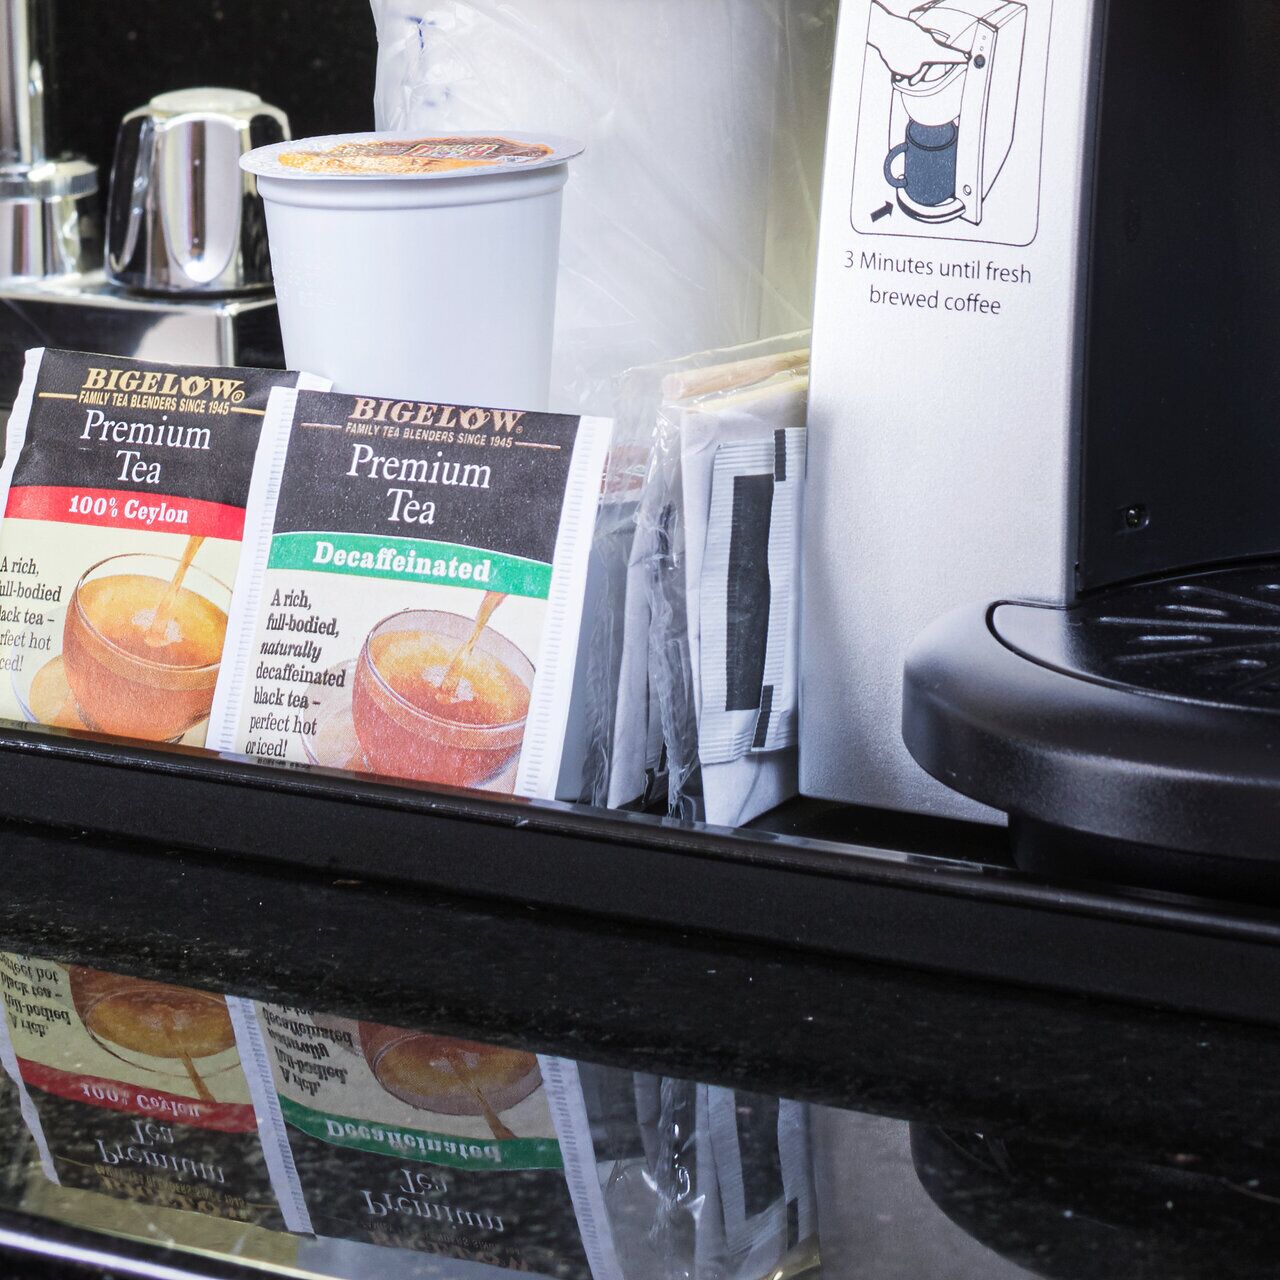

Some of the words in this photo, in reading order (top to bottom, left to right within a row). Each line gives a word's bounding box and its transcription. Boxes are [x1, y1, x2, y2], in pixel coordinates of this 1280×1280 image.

[843, 250, 854, 269] 3
[860, 251, 934, 276] Minutes
[939, 260, 981, 280] until
[986, 261, 1032, 284] fresh
[869, 284, 939, 309] brewed
[944, 293, 1002, 315] coffee
[78, 390, 110, 406] FAMILY
[112, 394, 128, 408] TEA
[130, 395, 177, 412] BLENDERS
[179, 398, 206, 414] SINCE
[208, 401, 230, 416] 1945
[79, 409, 211, 450] Premium
[345, 421, 380, 437] FAMILY
[382, 425, 400, 438] TEA
[402, 427, 455, 443] BLENDERS
[457, 432, 487, 446] SINCE
[489, 435, 514, 449] 1945
[115, 449, 162, 484] Tea
[345, 443, 492, 489] Premium
[68, 495, 118, 518] 100%
[124, 499, 189, 525] Ceylon
[386, 487, 436, 525] Tea
[0, 556, 8, 573] A
[11, 556, 40, 577] rich,
[312, 540, 493, 582] Decaffeinated
[270, 588, 281, 606] A
[283, 588, 312, 610] rich,
[23, 610, 44, 626] tea
[266, 613, 340, 638] full-bodied,
[28, 634, 52, 651] hot
[259, 639, 322, 663] naturally
[255, 661, 346, 688] decaffeinated
[253, 686, 284, 706] black
[287, 690, 309, 709] tea
[248, 713, 290, 734] perfect
[292, 714, 318, 736] hot
